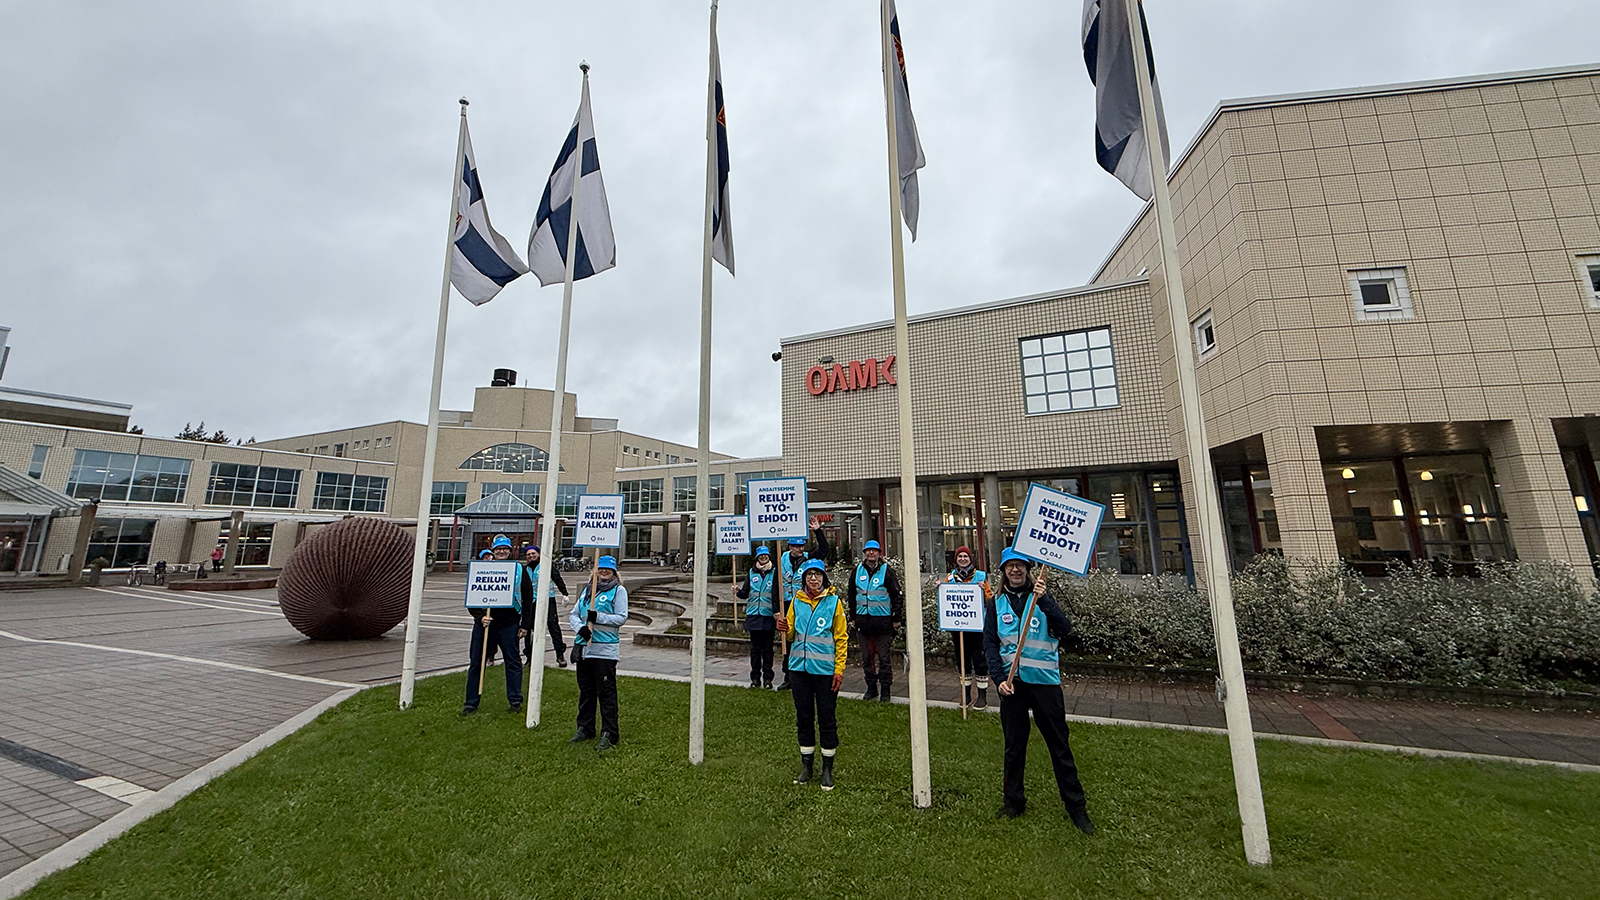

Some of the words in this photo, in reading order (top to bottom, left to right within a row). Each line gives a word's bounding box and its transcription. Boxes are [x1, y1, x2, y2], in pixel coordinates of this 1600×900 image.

[758, 493, 796, 503] REILUT
[764, 502, 790, 512] TYÖ-
[1042, 498, 1088, 517] ANSAITSEMME
[584, 512, 615, 520] REILUN
[758, 513, 798, 523] EHDOT!
[1038, 505, 1086, 528] REILUT
[580, 520, 618, 529] PALKAN!
[1042, 519, 1075, 536] TYÖ-
[1029, 528, 1081, 553] EHDOT!
[1049, 551, 1062, 559] OAJ
[471, 584, 511, 592] PALKAN!
[946, 594, 975, 602] REILUT
[950, 601, 971, 610] TYÖ-
[945, 610, 977, 618] EHDOT!
